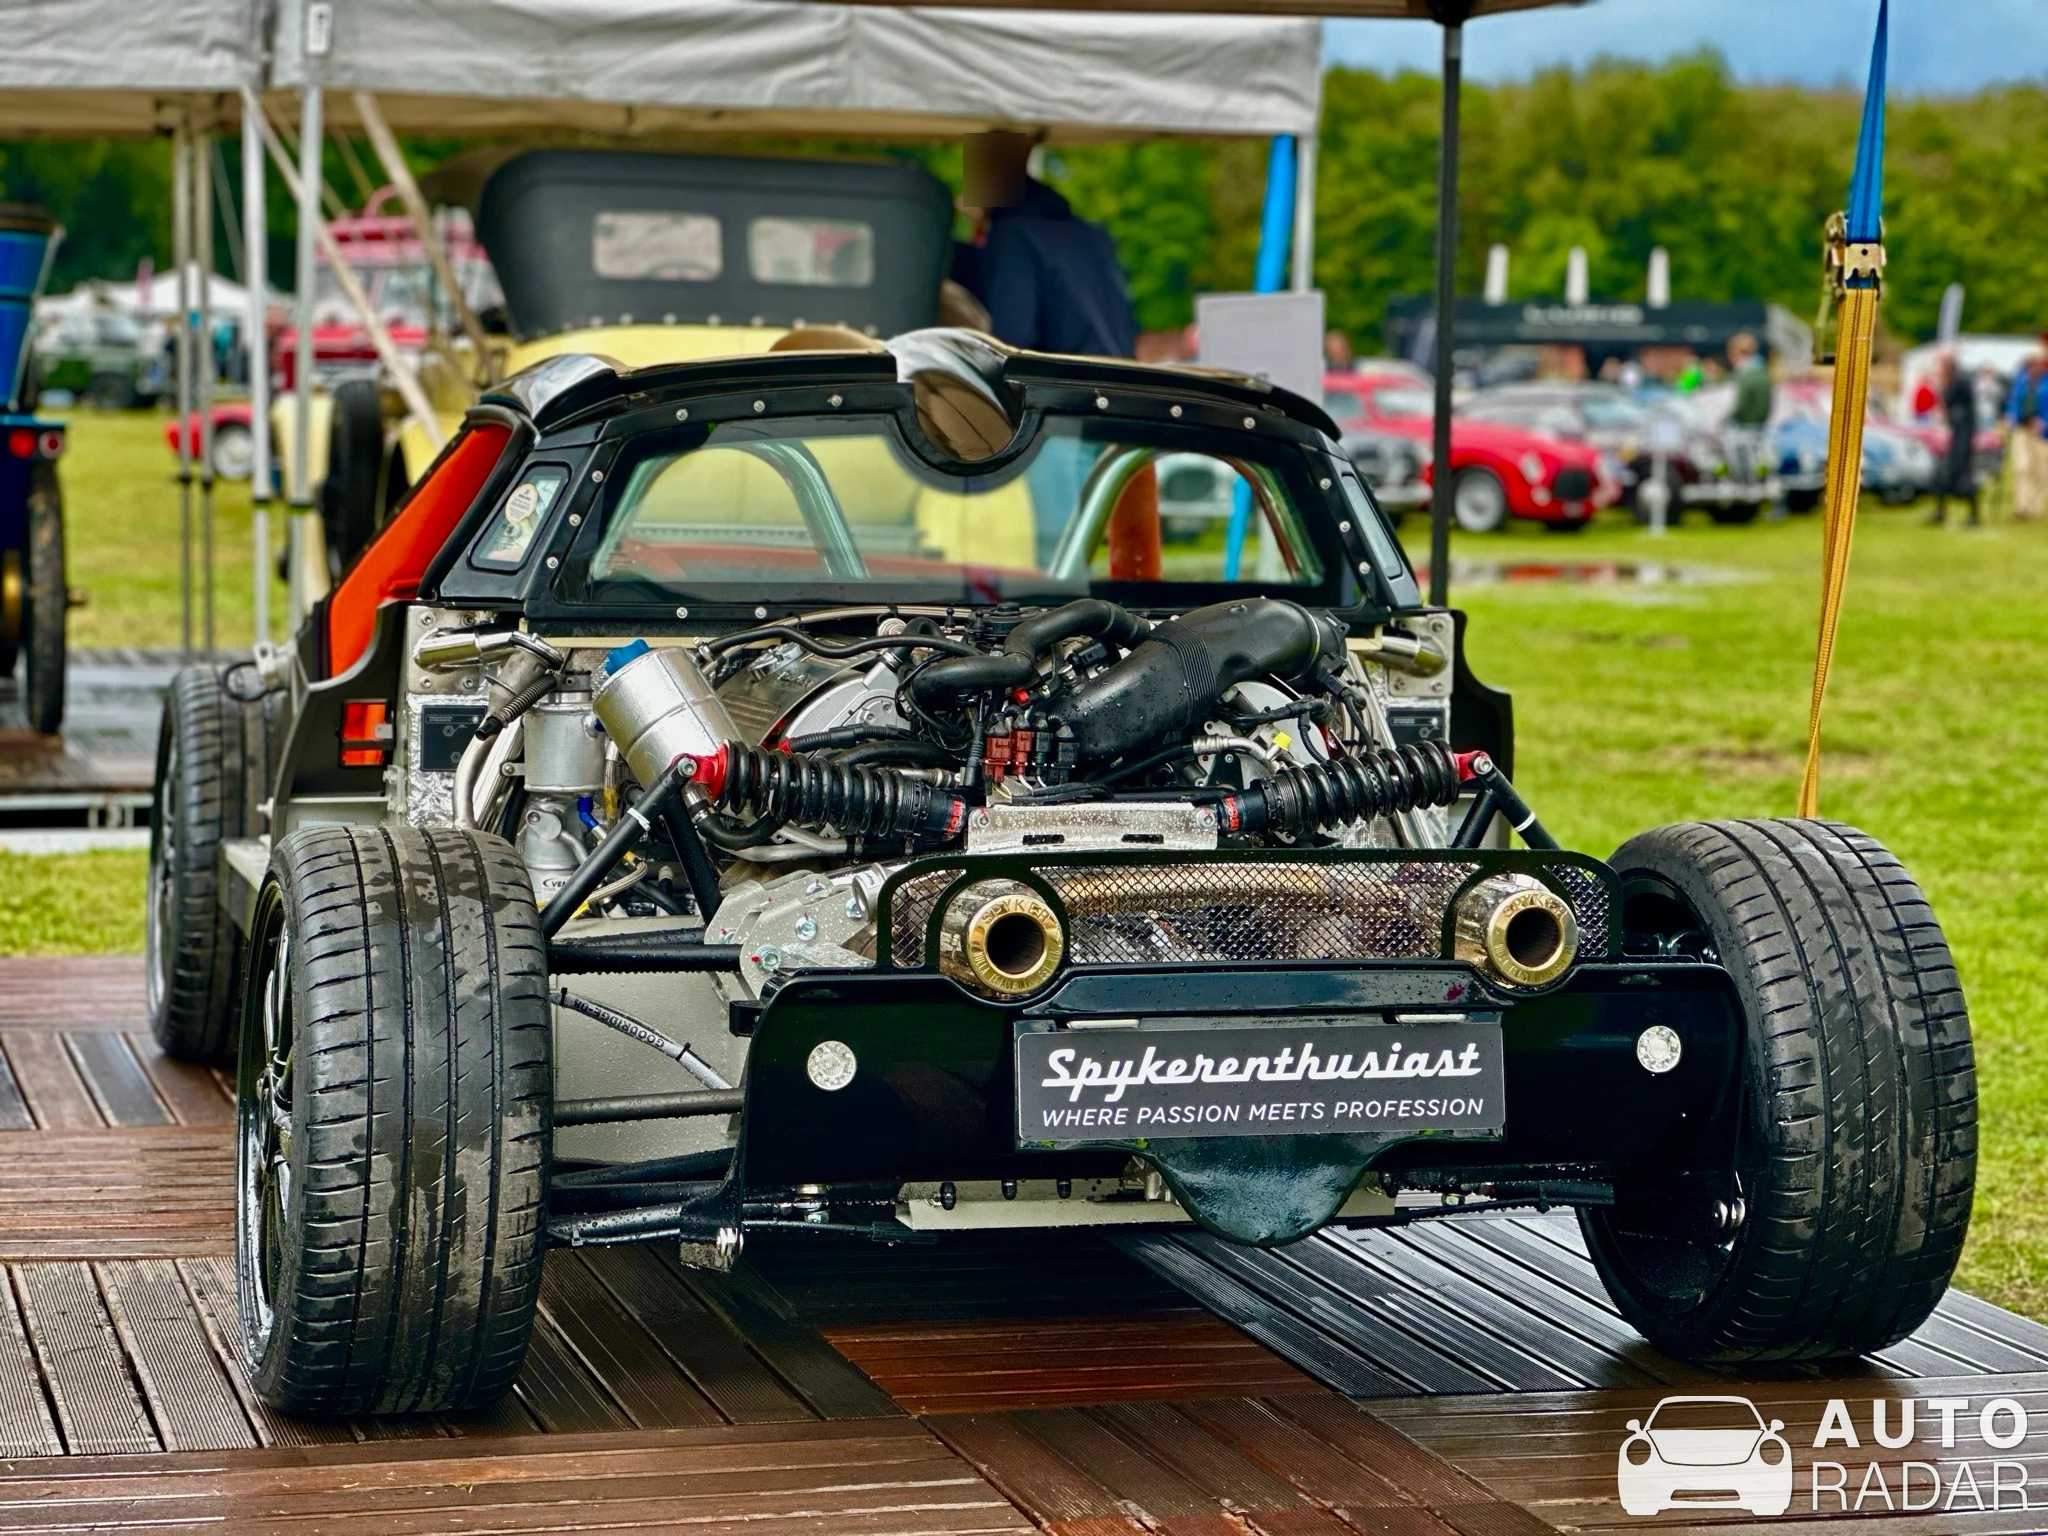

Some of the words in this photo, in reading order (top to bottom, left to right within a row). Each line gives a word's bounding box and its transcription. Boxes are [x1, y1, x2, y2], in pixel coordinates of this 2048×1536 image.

[980, 898, 1057, 926] SPYKER
[1502, 893, 1568, 920] SPYKER
[1041, 1042, 1482, 1103] Spykerenthusiast
[1042, 1107, 1129, 1127] WHERE
[1136, 1104, 1240, 1124] PASSION
[1248, 1102, 1325, 1121] MEETS
[1334, 1098, 1484, 1118] PROFESSION
